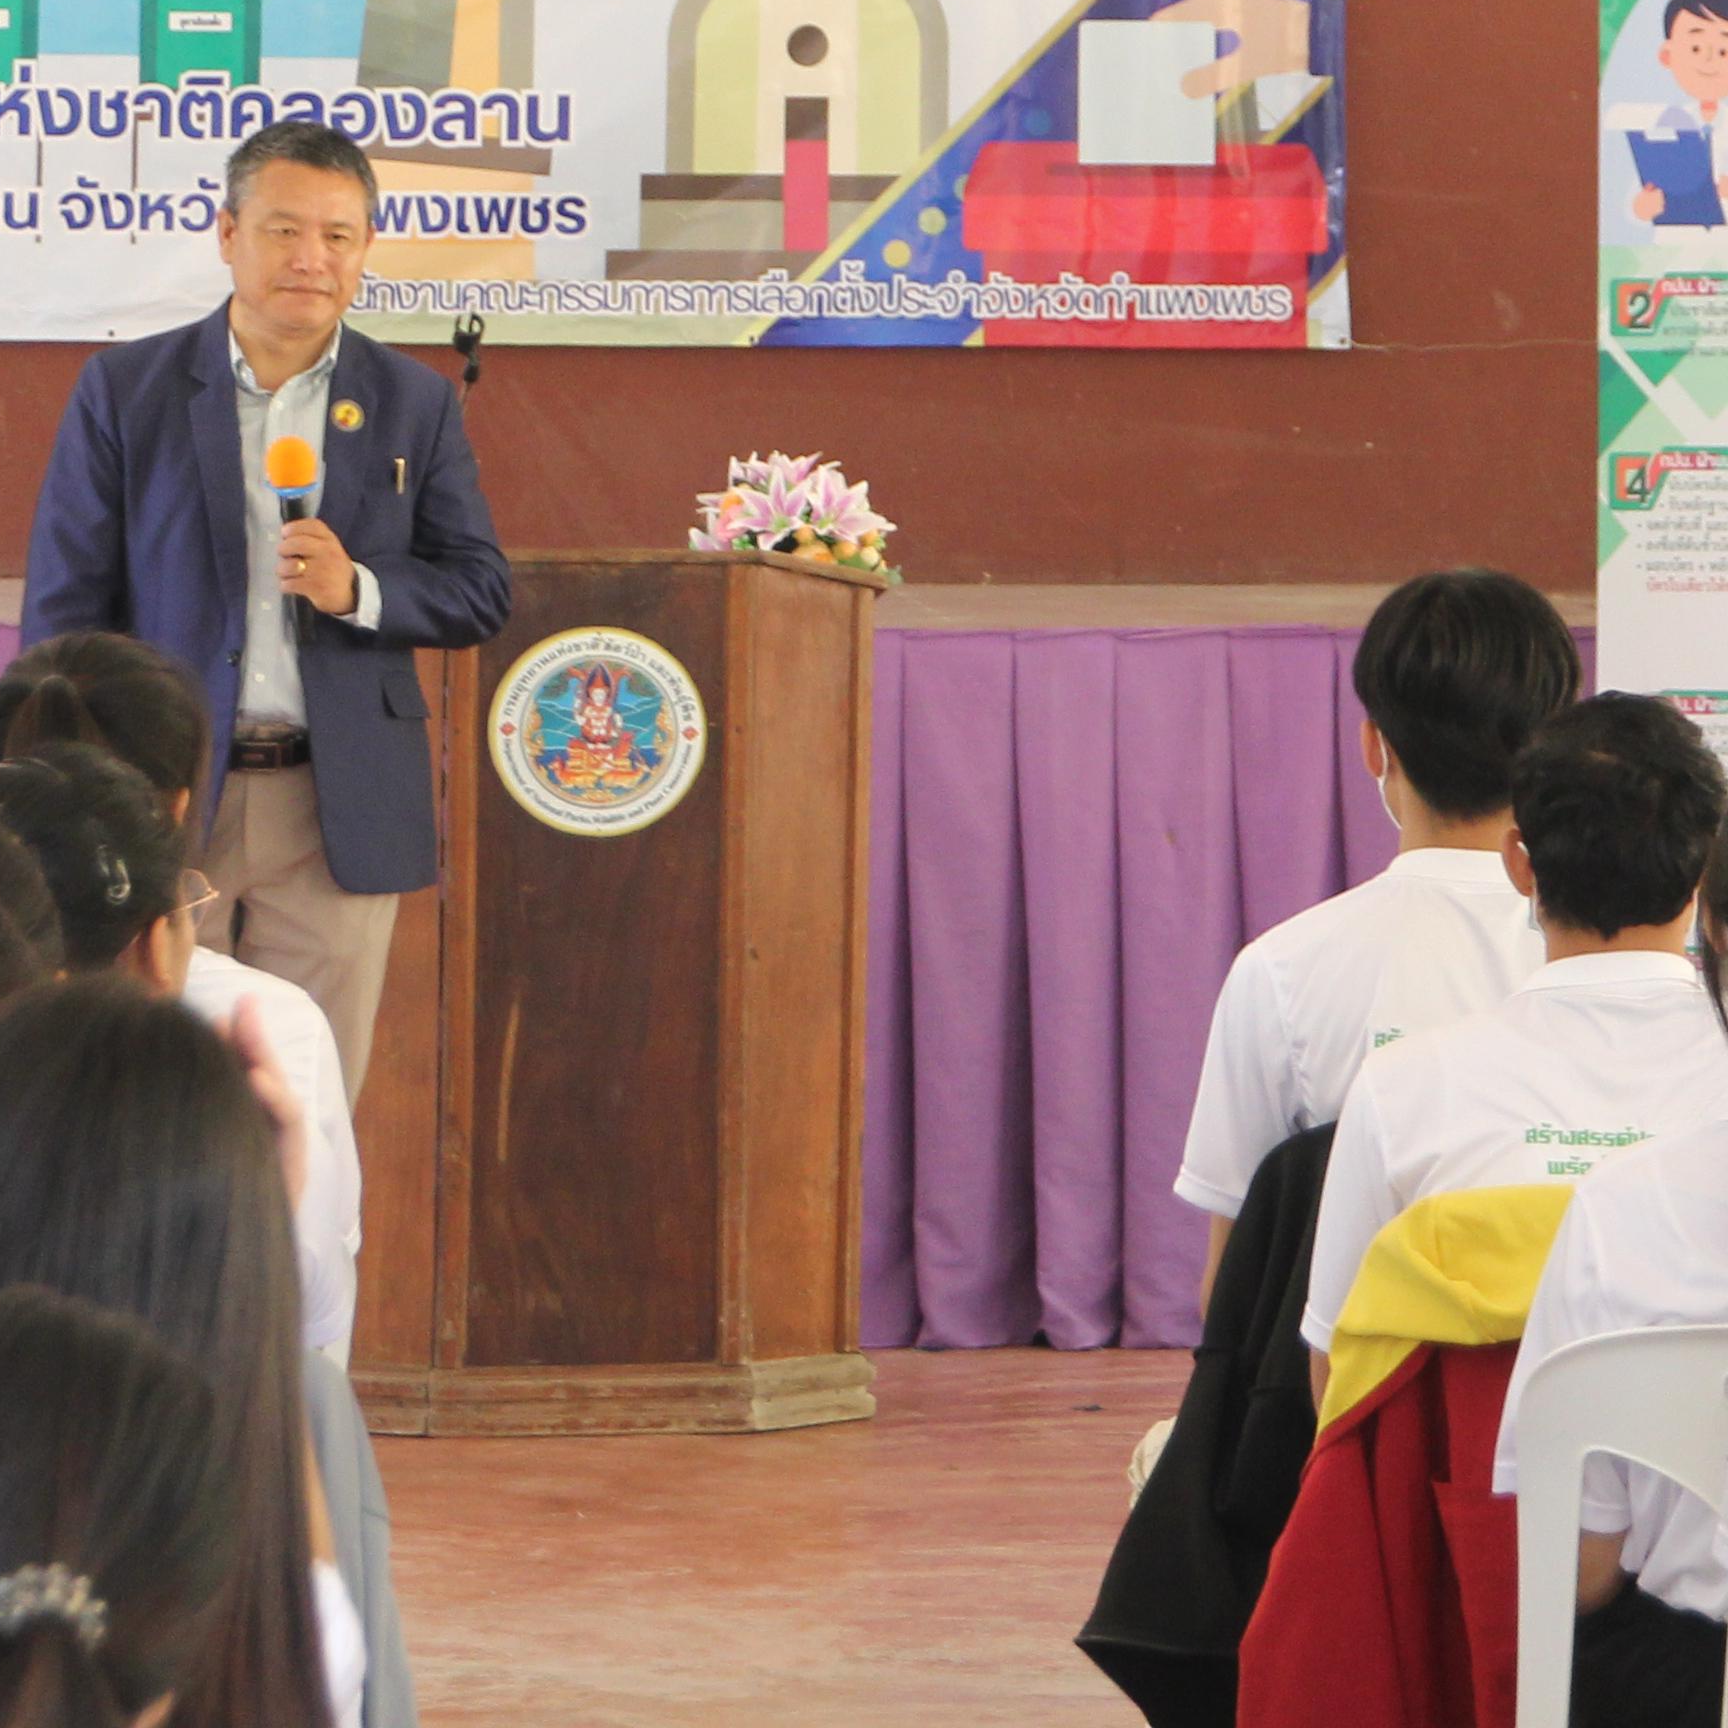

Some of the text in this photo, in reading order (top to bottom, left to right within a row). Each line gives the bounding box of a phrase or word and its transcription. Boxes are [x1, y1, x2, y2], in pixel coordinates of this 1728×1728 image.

[62, 177, 587, 238] จังหวัพงเพชร
[352, 262, 1291, 319] นักงานคณะกรรมการการเลือกตั้งประจำจังหวัดกำแพงเพชร
[1629, 291, 1652, 330] 2
[1626, 465, 1651, 505] 4
